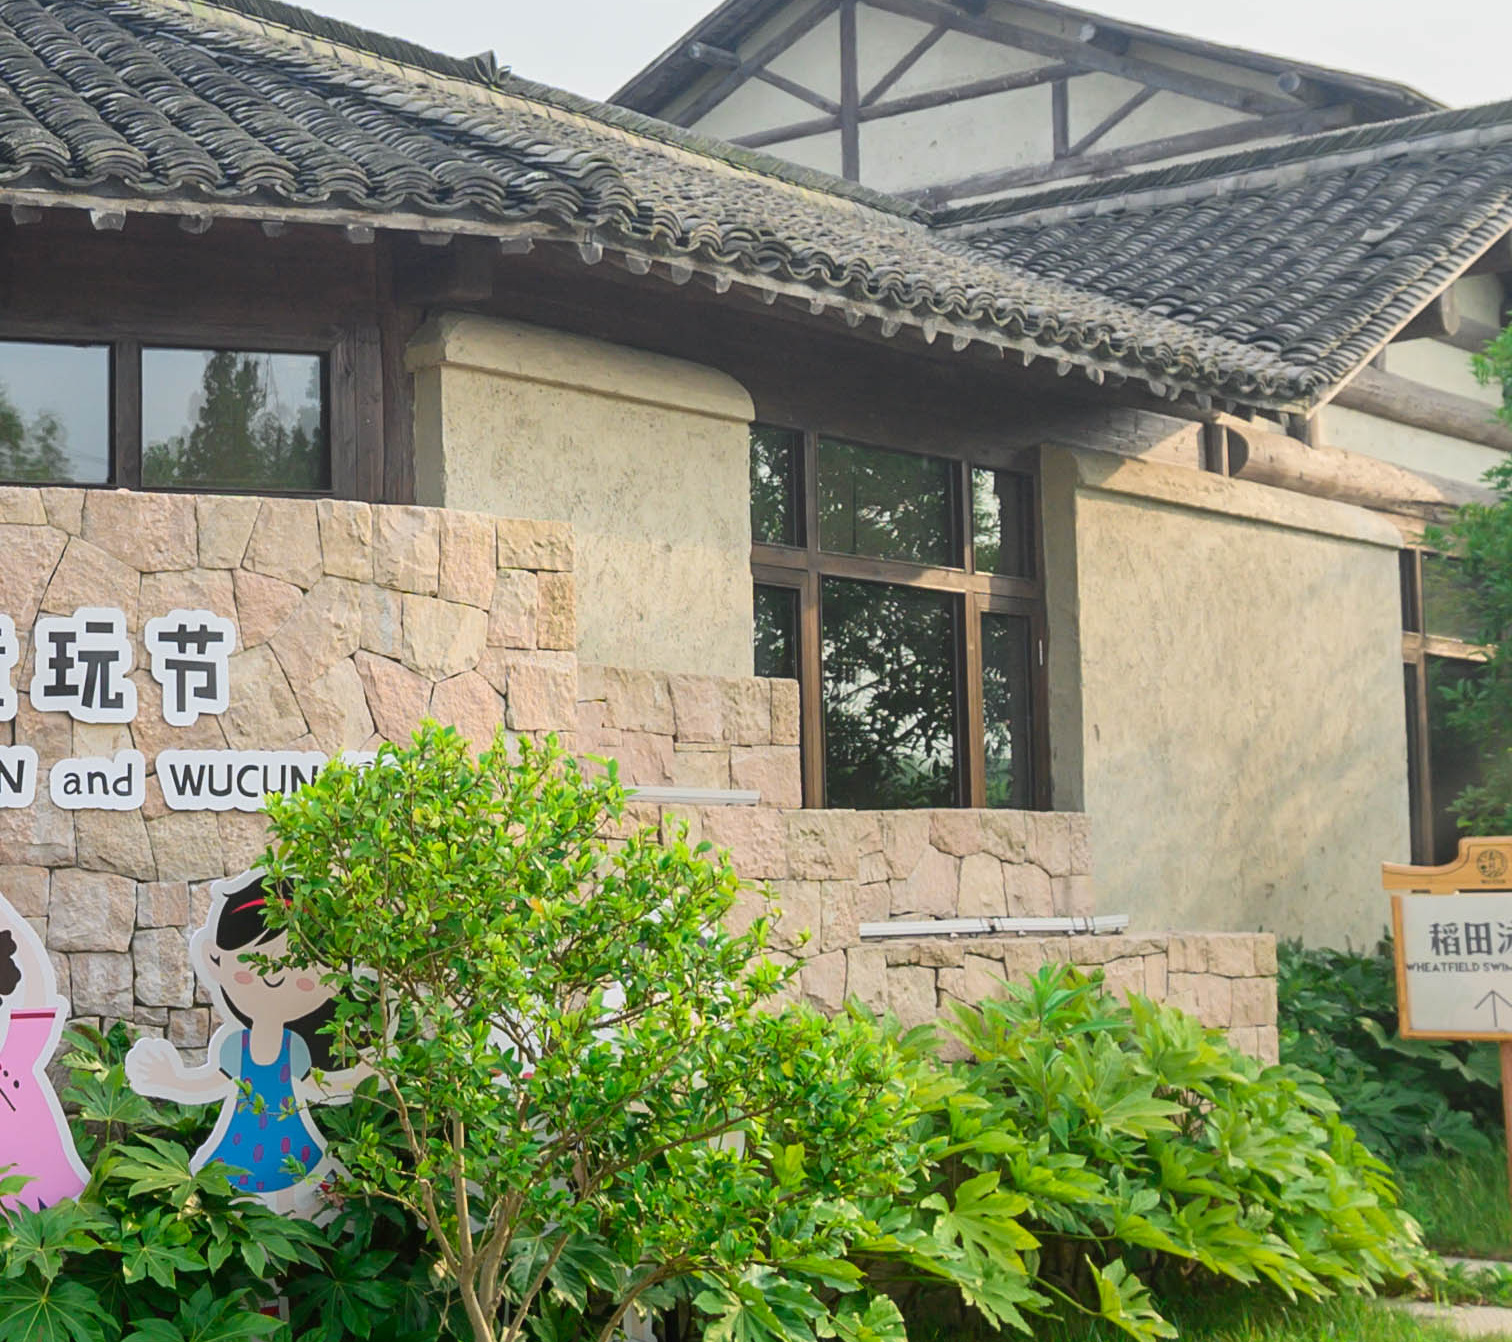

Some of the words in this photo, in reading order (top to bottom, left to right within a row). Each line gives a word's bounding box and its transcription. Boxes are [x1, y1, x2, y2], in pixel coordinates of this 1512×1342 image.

[62, 762, 133, 797] and
[169, 763, 318, 798] WUCUN
[1406, 961, 1480, 973] WHEATFIELD
